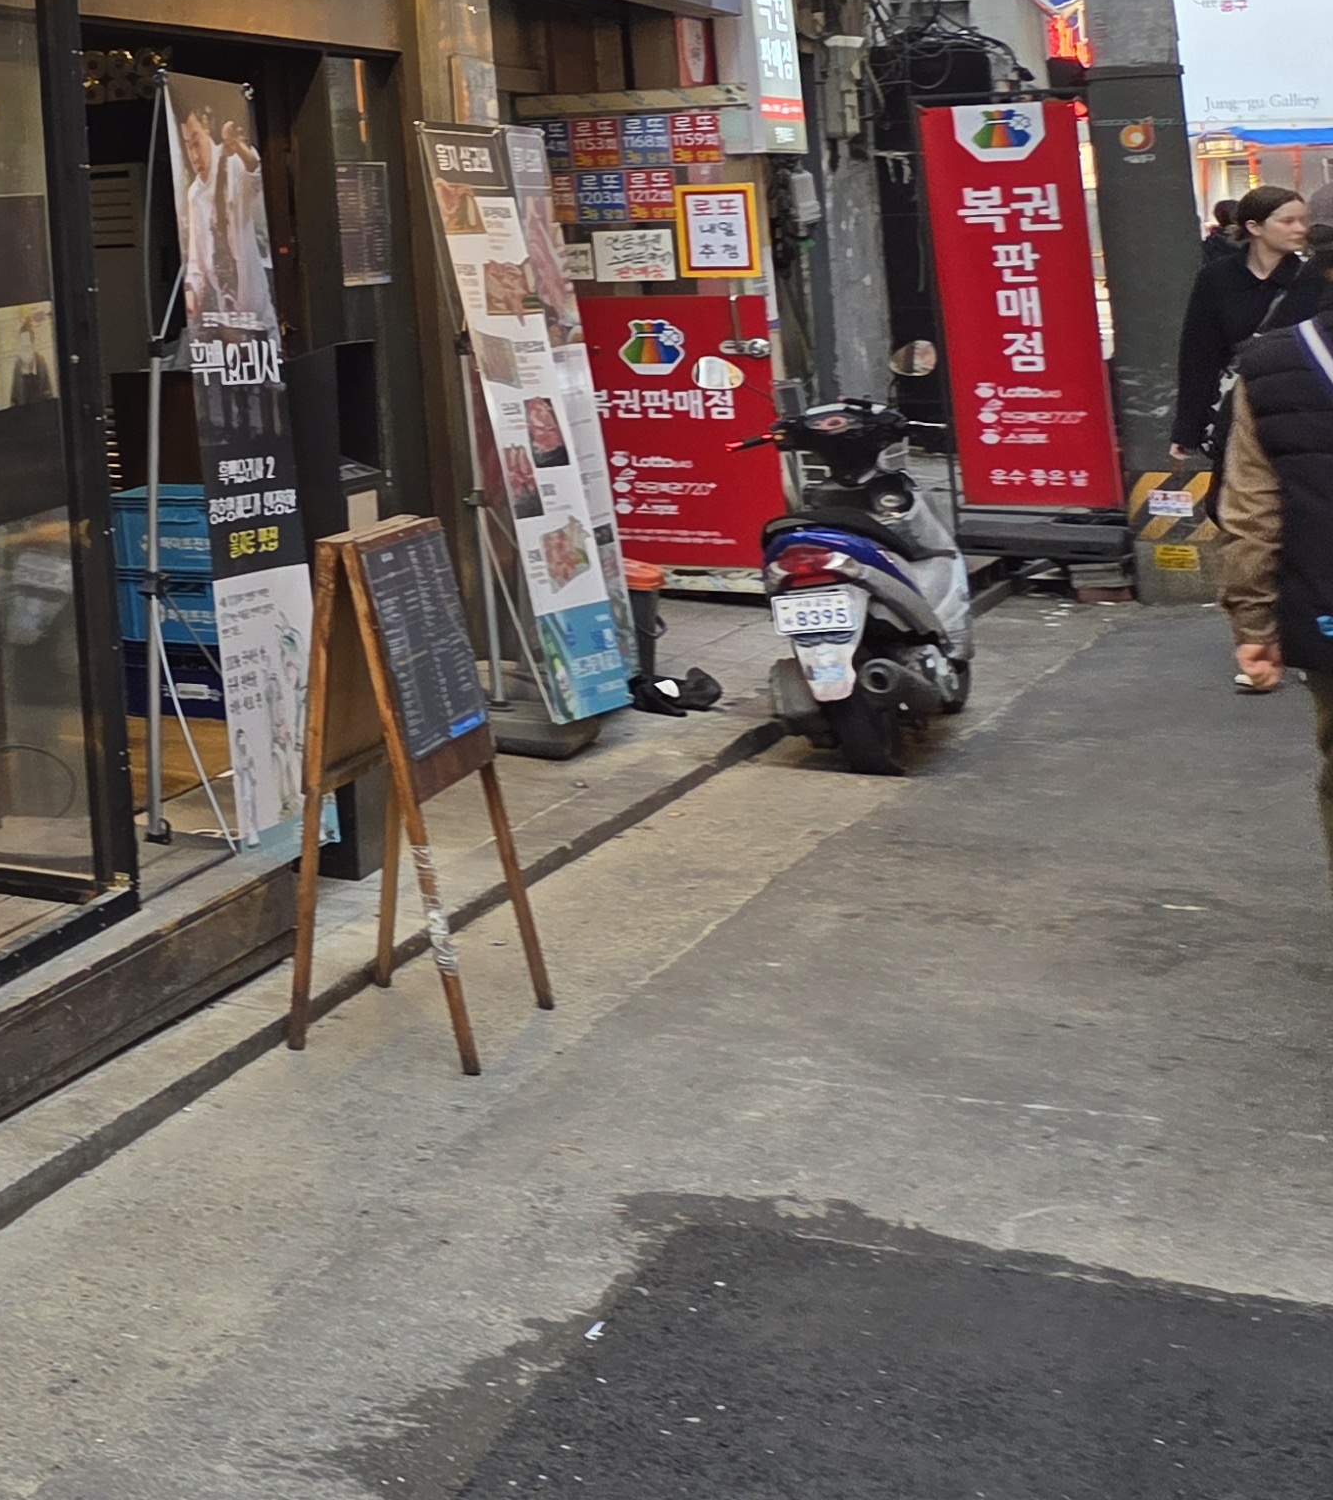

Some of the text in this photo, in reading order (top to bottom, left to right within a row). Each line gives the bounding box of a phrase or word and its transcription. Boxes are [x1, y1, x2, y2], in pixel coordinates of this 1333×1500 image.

[760, 37, 794, 81] 판매점
[1204, 93, 1320, 113] Jung-gu Gallery
[574, 120, 615, 137] 로또
[624, 118, 665, 134] 로또
[673, 116, 715, 132] 로또
[581, 174, 621, 190] 로또
[628, 172, 670, 189] 로또
[692, 199, 740, 216] 로또
[956, 183, 1064, 233] 복권
[698, 221, 737, 237] 내일
[698, 243, 740, 260] 추첨
[991, 241, 1046, 372] 판매점
[265, 456, 276, 480] 2
[989, 468, 1027, 486] 운수
[1069, 470, 1090, 487] 날
[795, 607, 848, 627] 8395
